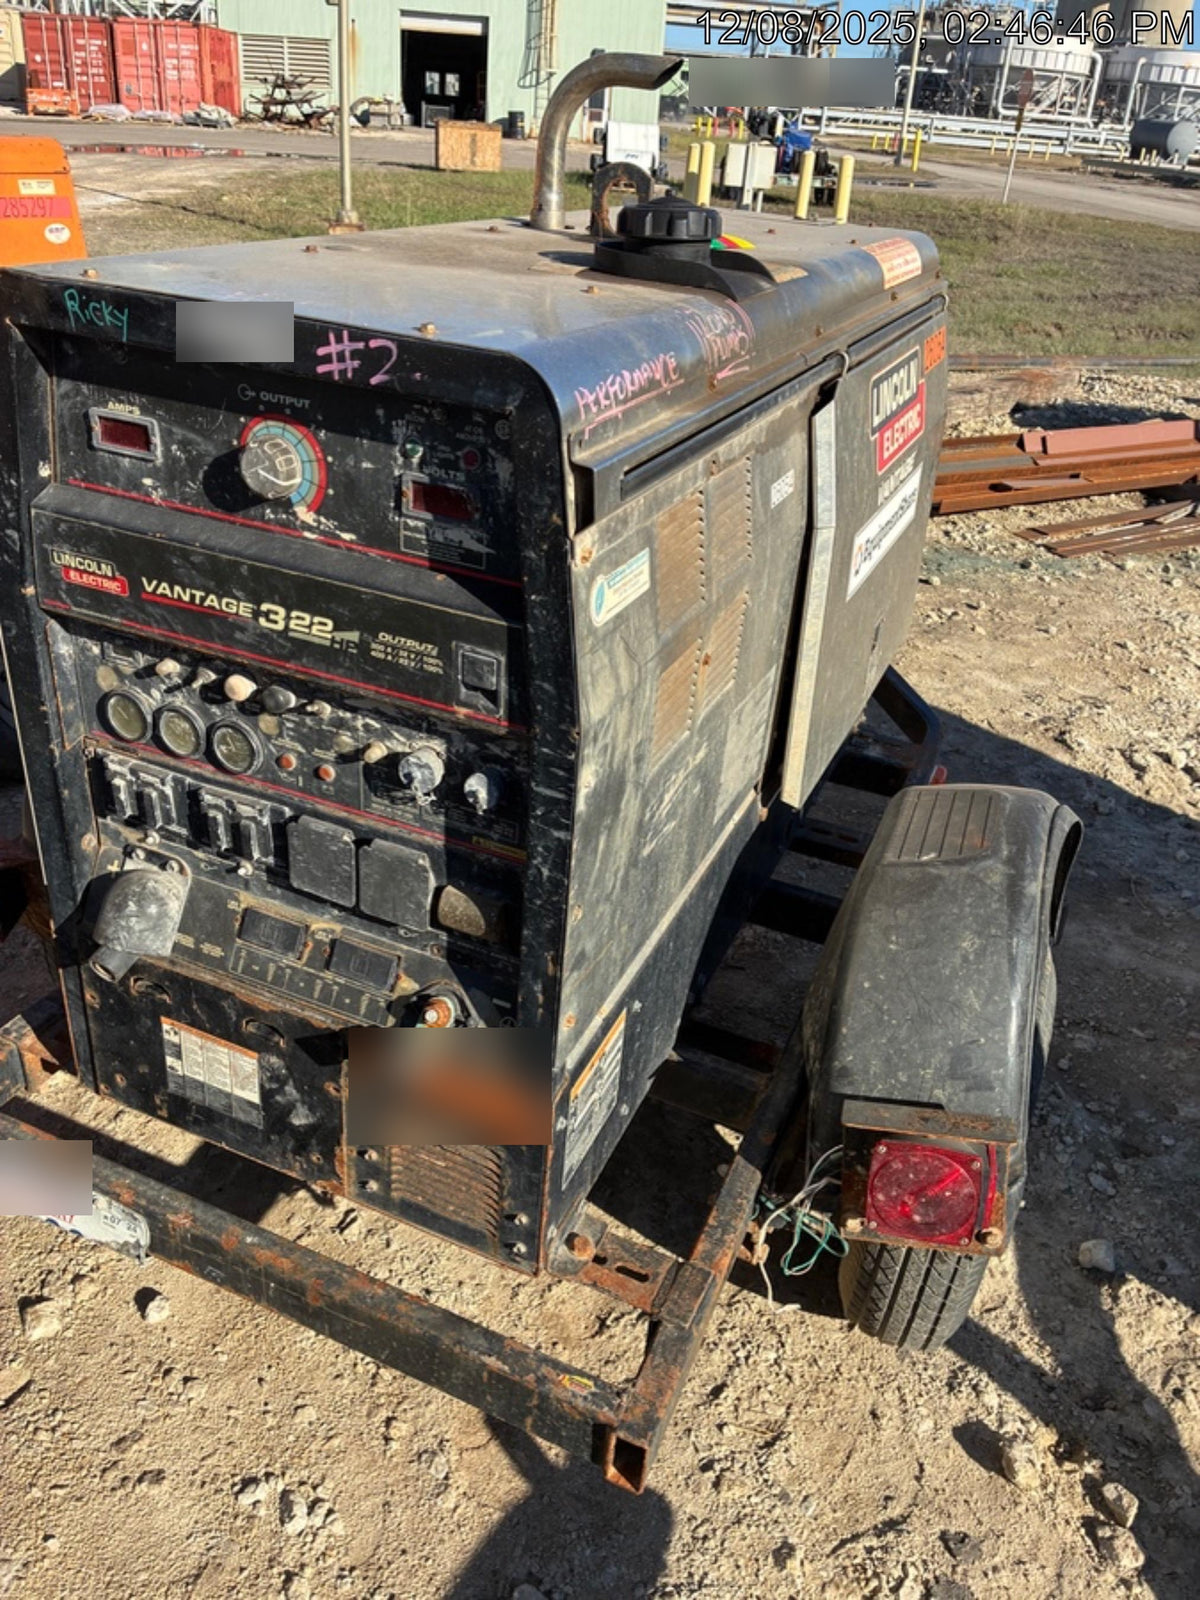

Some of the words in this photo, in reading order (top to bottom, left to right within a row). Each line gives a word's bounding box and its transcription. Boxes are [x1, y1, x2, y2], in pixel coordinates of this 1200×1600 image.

[316, 328, 398, 386] #2
[259, 389, 312, 409] OUTPUT
[872, 356, 919, 429] LINCOLN
[107, 400, 141, 416] AMPS
[882, 401, 922, 461] ELECTRIC
[422, 464, 467, 482] VOLTS
[52, 551, 113, 577] LINCOLN
[69, 570, 122, 592] ELECTRIC
[141, 576, 254, 618] VANTAGE
[257, 602, 335, 639] 322
[377, 631, 435, 652] OUTPUT
